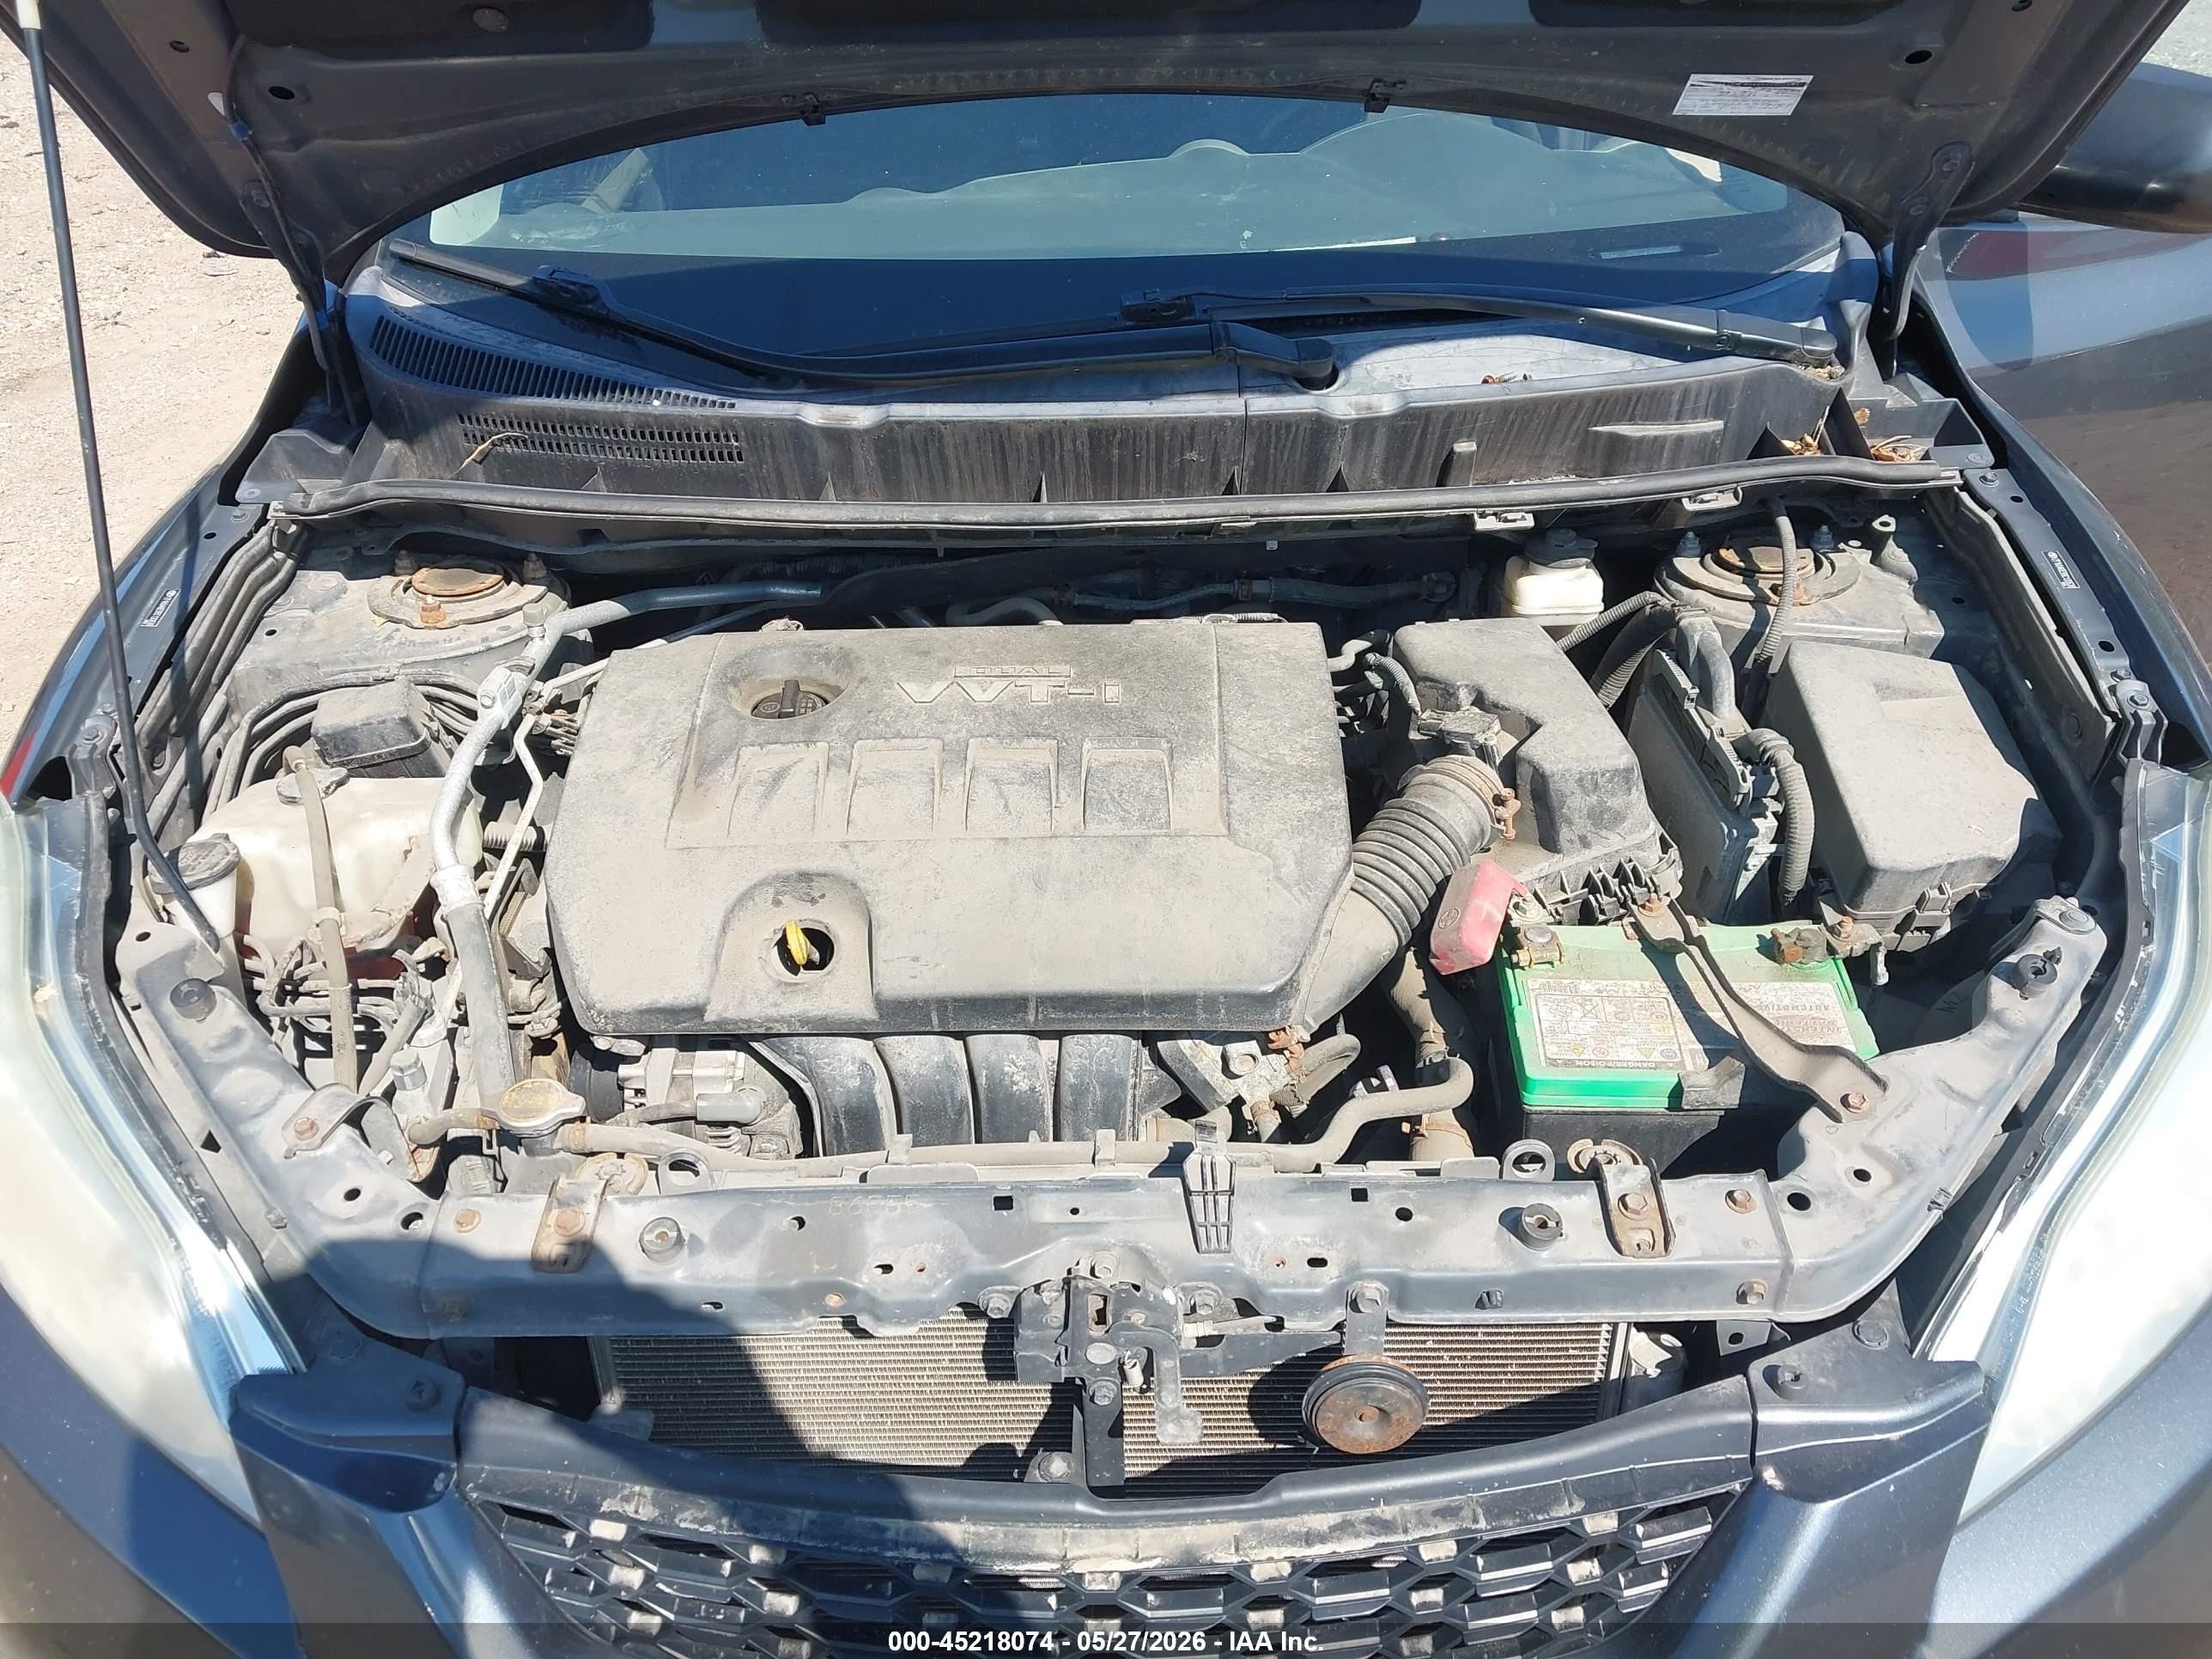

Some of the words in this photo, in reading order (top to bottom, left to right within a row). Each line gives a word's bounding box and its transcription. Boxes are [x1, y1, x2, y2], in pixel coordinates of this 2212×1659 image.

[969, 665, 1060, 675] DUAL
[1757, 1004, 1829, 1012] AUTOMOTIVE
[1575, 1059, 1656, 1068] DANGER/POISON
